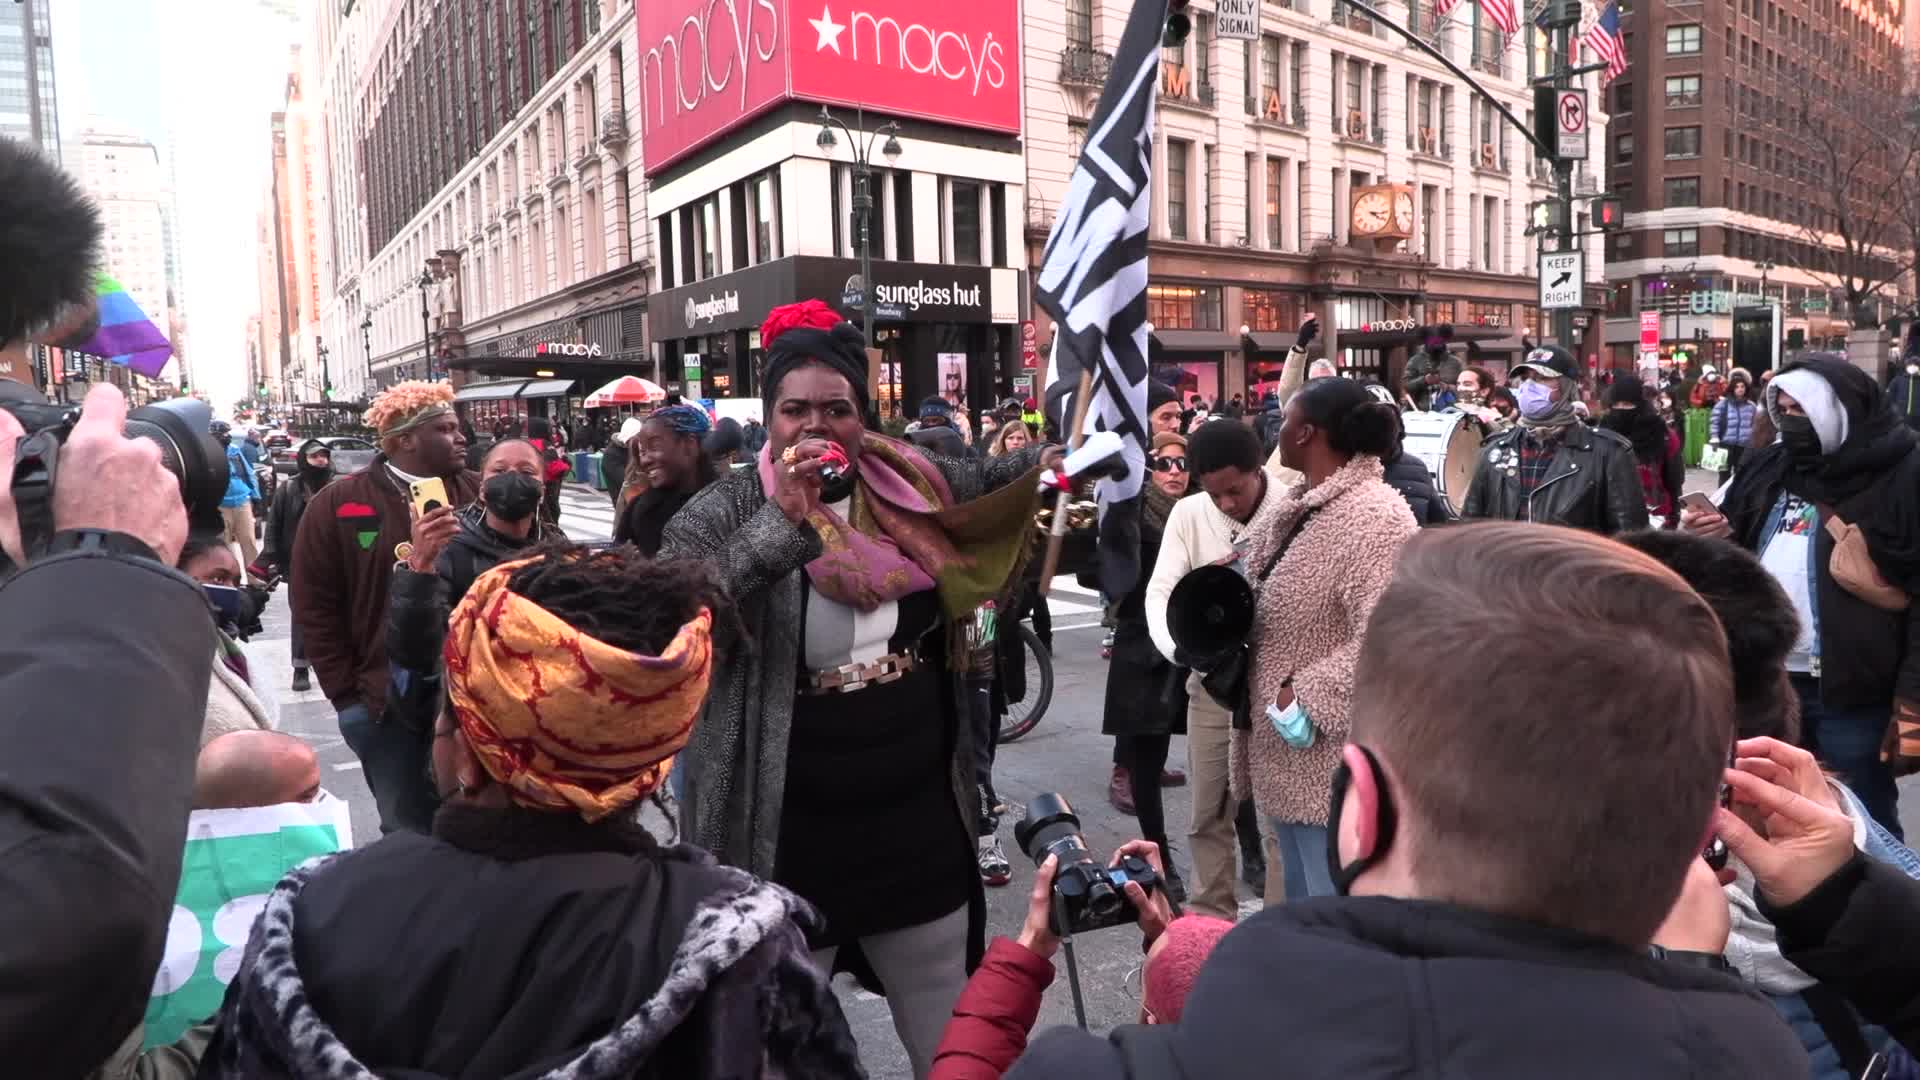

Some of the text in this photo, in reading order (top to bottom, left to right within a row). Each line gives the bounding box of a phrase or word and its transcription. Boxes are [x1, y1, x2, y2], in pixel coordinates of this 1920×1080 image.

[1222, 0, 1254, 15] ONLY
[1219, 17, 1256, 35] SIGNAL
[851, 11, 1005, 96] macy's
[643, 0, 777, 136] macys
[1547, 257, 1575, 268] KEEP
[876, 280, 981, 311] sunglass hut
[1545, 291, 1576, 302] RIGHT
[1371, 315, 1415, 333] macy's
[548, 342, 601, 359] macy's
